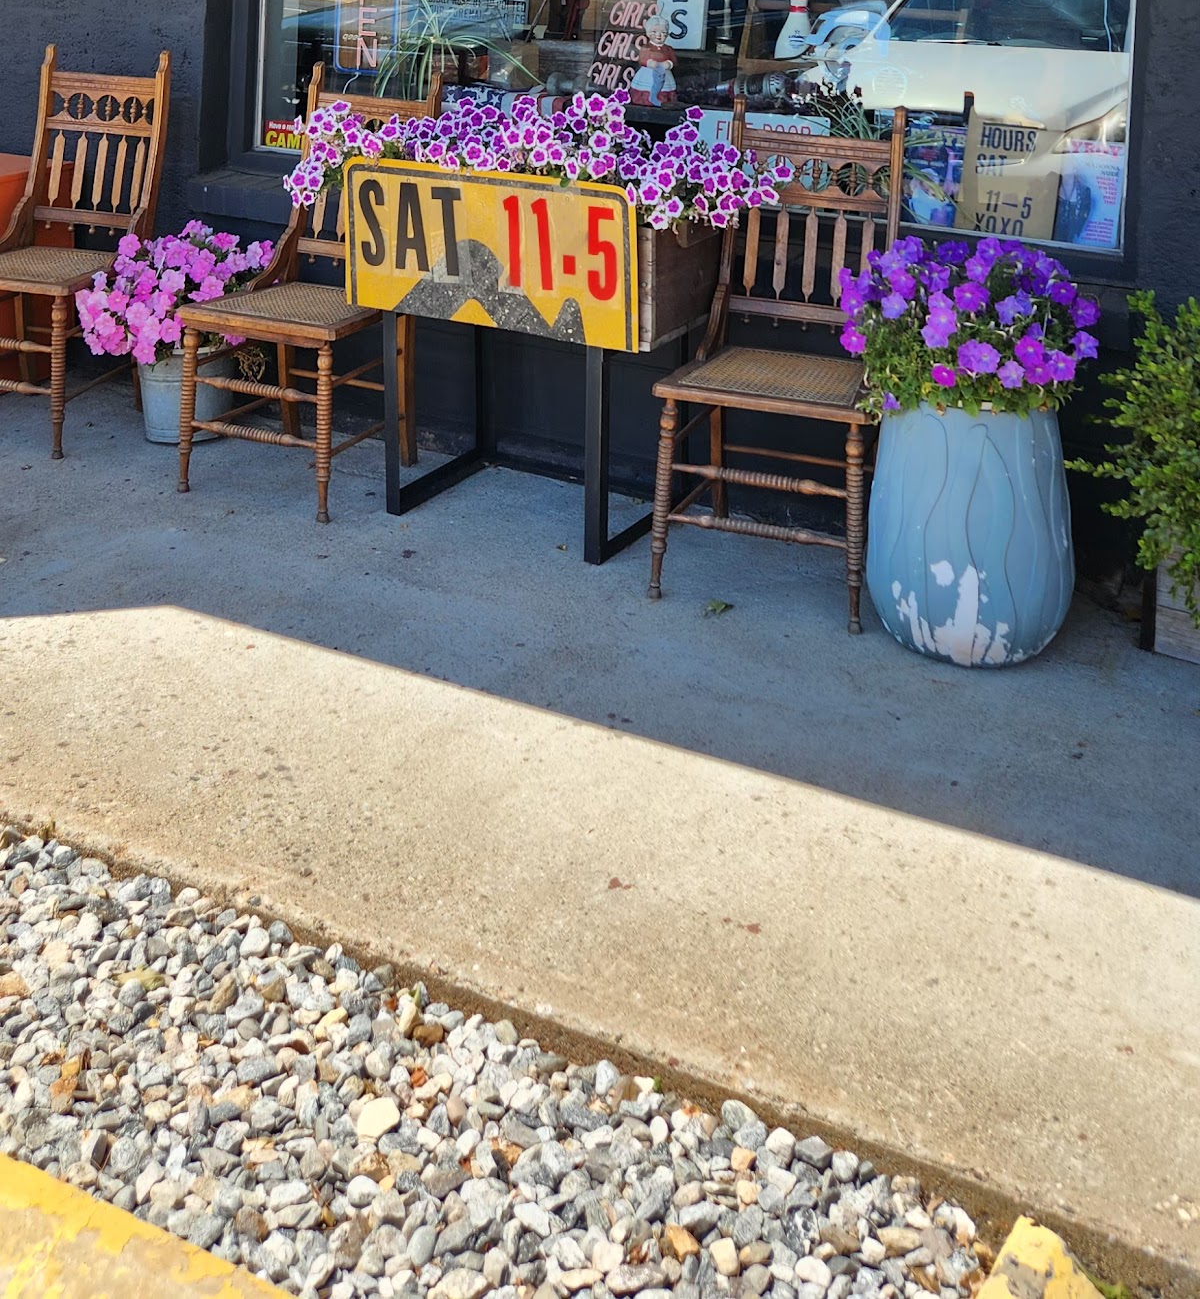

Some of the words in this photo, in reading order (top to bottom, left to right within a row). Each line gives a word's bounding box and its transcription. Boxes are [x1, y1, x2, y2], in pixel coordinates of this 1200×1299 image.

[609, 0, 658, 29] GIRLS
[598, 30, 648, 62] GIRLS
[587, 61, 636, 91] GIRLS
[265, 130, 306, 150] CAM
[980, 126, 1037, 152] HOURS
[975, 154, 1008, 177] SAT
[358, 179, 461, 277] SAT
[974, 212, 1024, 237] XOXO
